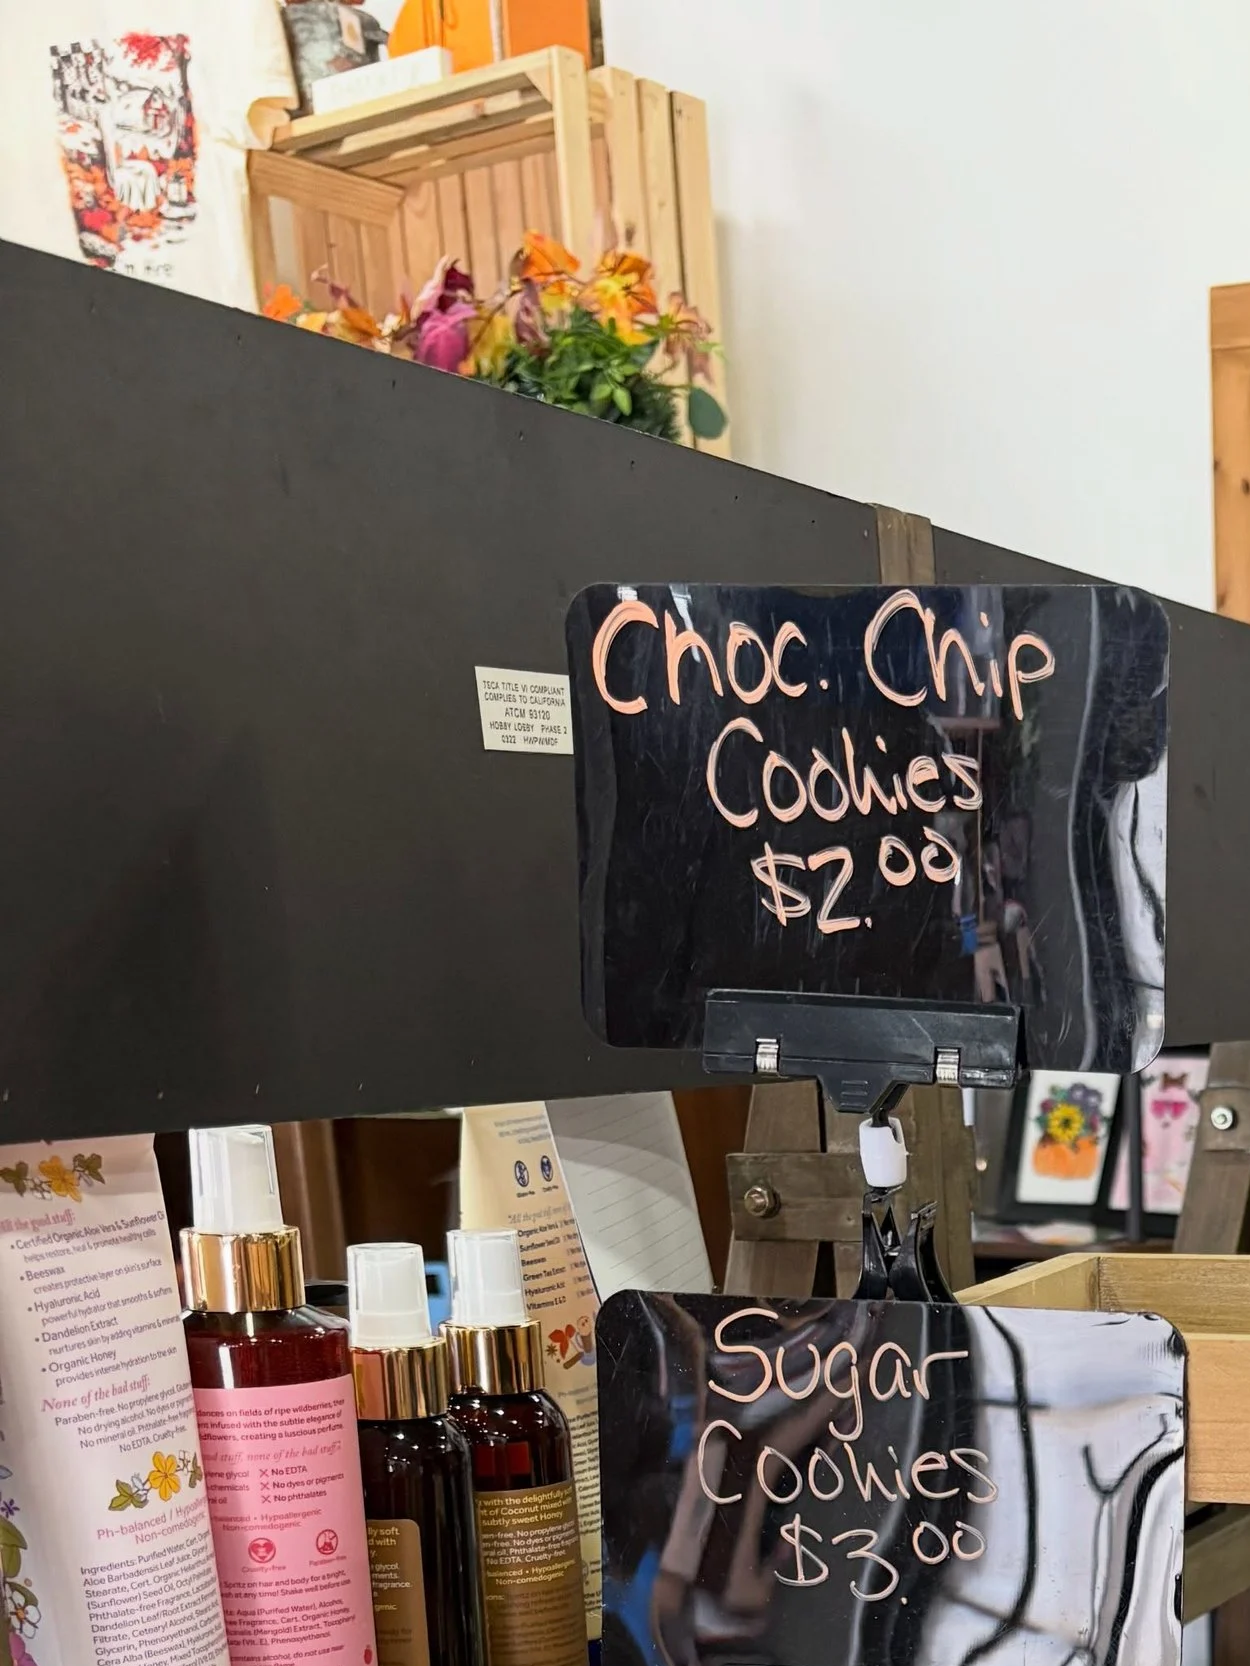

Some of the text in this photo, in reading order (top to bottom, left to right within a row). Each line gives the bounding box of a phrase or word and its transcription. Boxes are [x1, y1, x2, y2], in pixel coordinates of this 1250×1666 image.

[592, 588, 1055, 721] Choc. Chip
[502, 682, 519, 692] TITLE
[530, 685, 564, 696] COMPLIANT
[485, 692, 565, 706] COMPLIES TO CALIFORNIA
[505, 707, 525, 718] ATCM
[490, 721, 511, 730] HOBBY
[541, 725, 561, 734] PHASE
[16, 1236, 52, 1250] Certified
[52, 1229, 85, 1244] Organic
[26, 1266, 65, 1281] Beeswax
[64, 1273, 99, 1290] protective
[34, 1288, 101, 1313] Hyaluronic Acid
[41, 1310, 78, 1326] powerful
[41, 1316, 119, 1343] Dandelion Extract
[49, 1341, 86, 1356] nurtures
[48, 1349, 117, 1373] Organic Honey
[55, 1370, 94, 1387] provides
[708, 1306, 969, 1441] Sugar
[41, 1374, 150, 1412] None of the bad stuff:
[54, 1407, 116, 1426] Paraben-free.
[78, 1425, 93, 1435] No
[93, 1419, 120, 1433] drying
[80, 1439, 95, 1449] No
[96, 1430, 127, 1444] mineral
[271, 1465, 307, 1476] No EDTA
[287, 1490, 327, 1503] phthalates
[501, 1505, 539, 1516] Coconut
[97, 1513, 167, 1540] Ph-balanced
[775, 1512, 989, 1604] $3.00
[80, 1558, 137, 1576] Ingredients:
[83, 1578, 105, 1587] Aloe
[107, 1566, 159, 1583] Barbadensis
[91, 1618, 140, 1633] Dandelion
